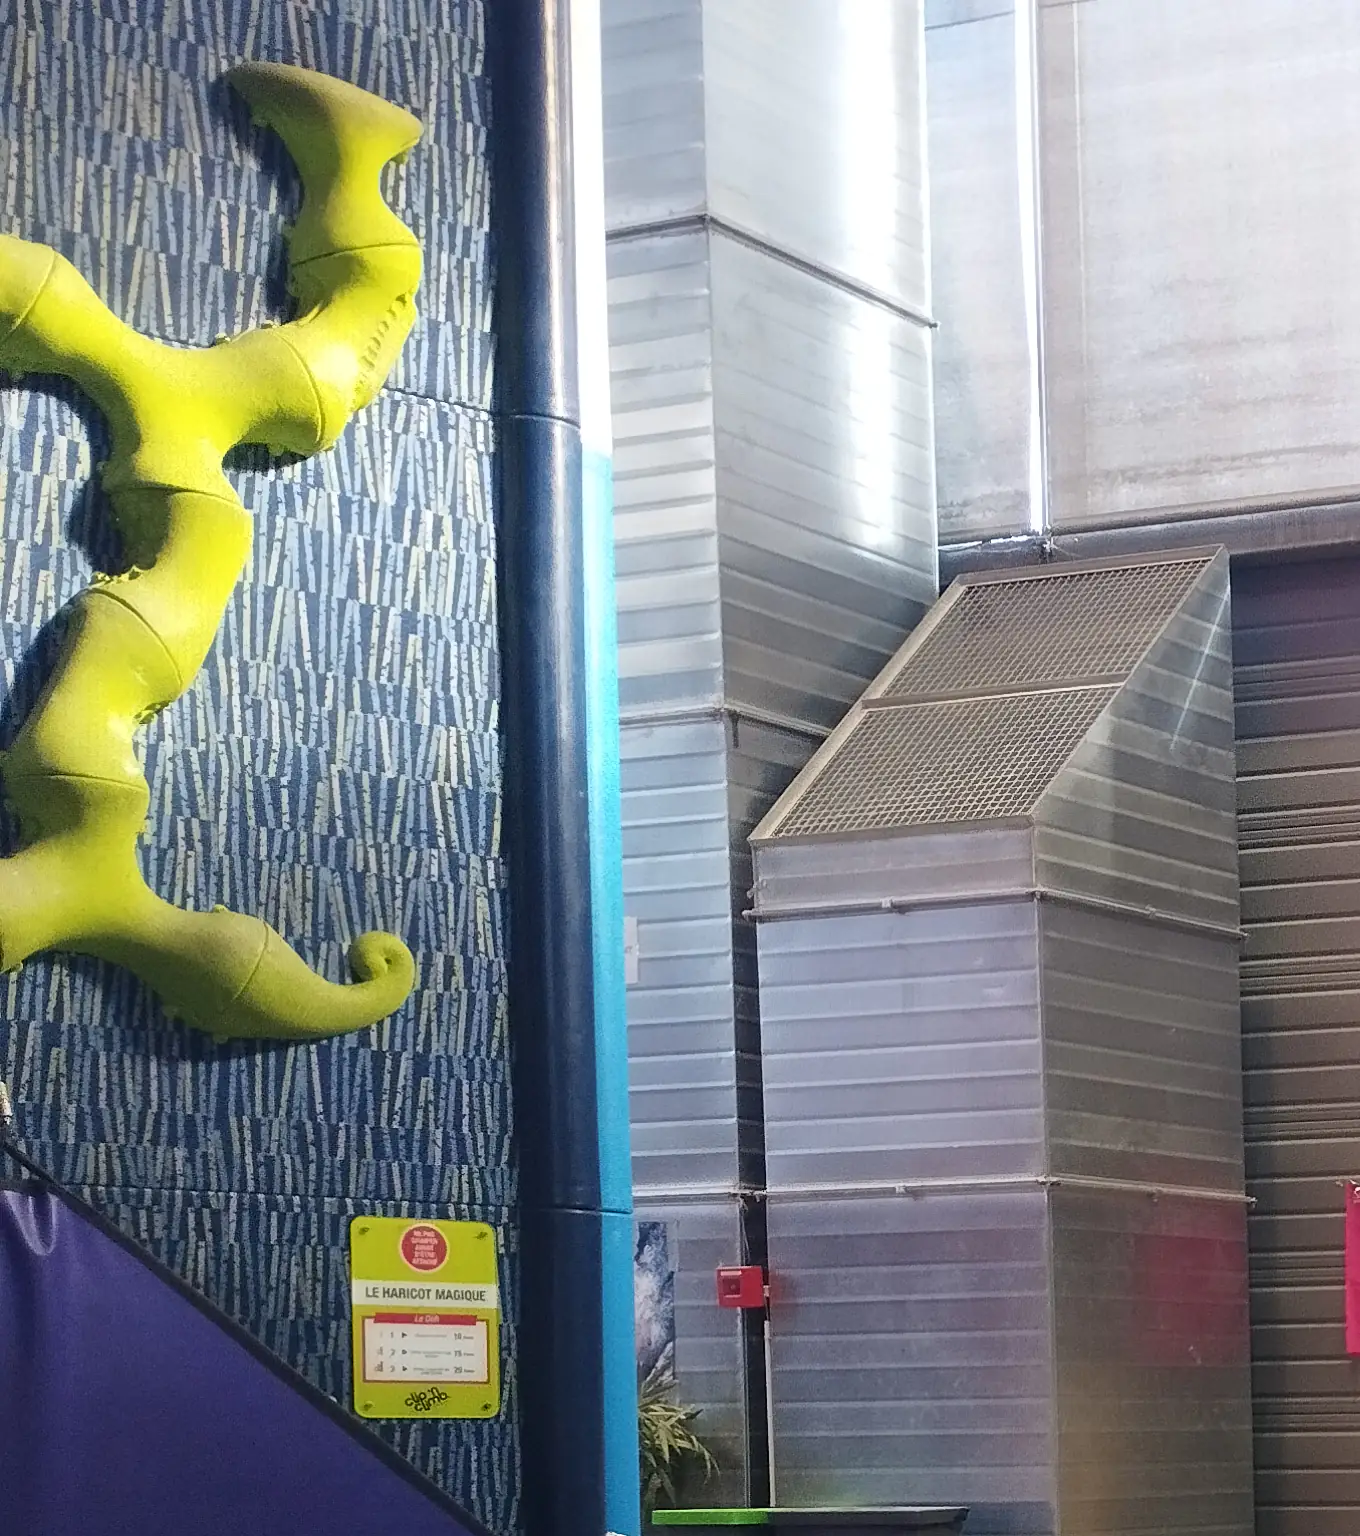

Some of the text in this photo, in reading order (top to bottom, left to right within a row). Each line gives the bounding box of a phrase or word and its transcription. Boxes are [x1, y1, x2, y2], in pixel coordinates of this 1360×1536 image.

[365, 1286, 486, 1302] LE HARICOT MAGIQUE
